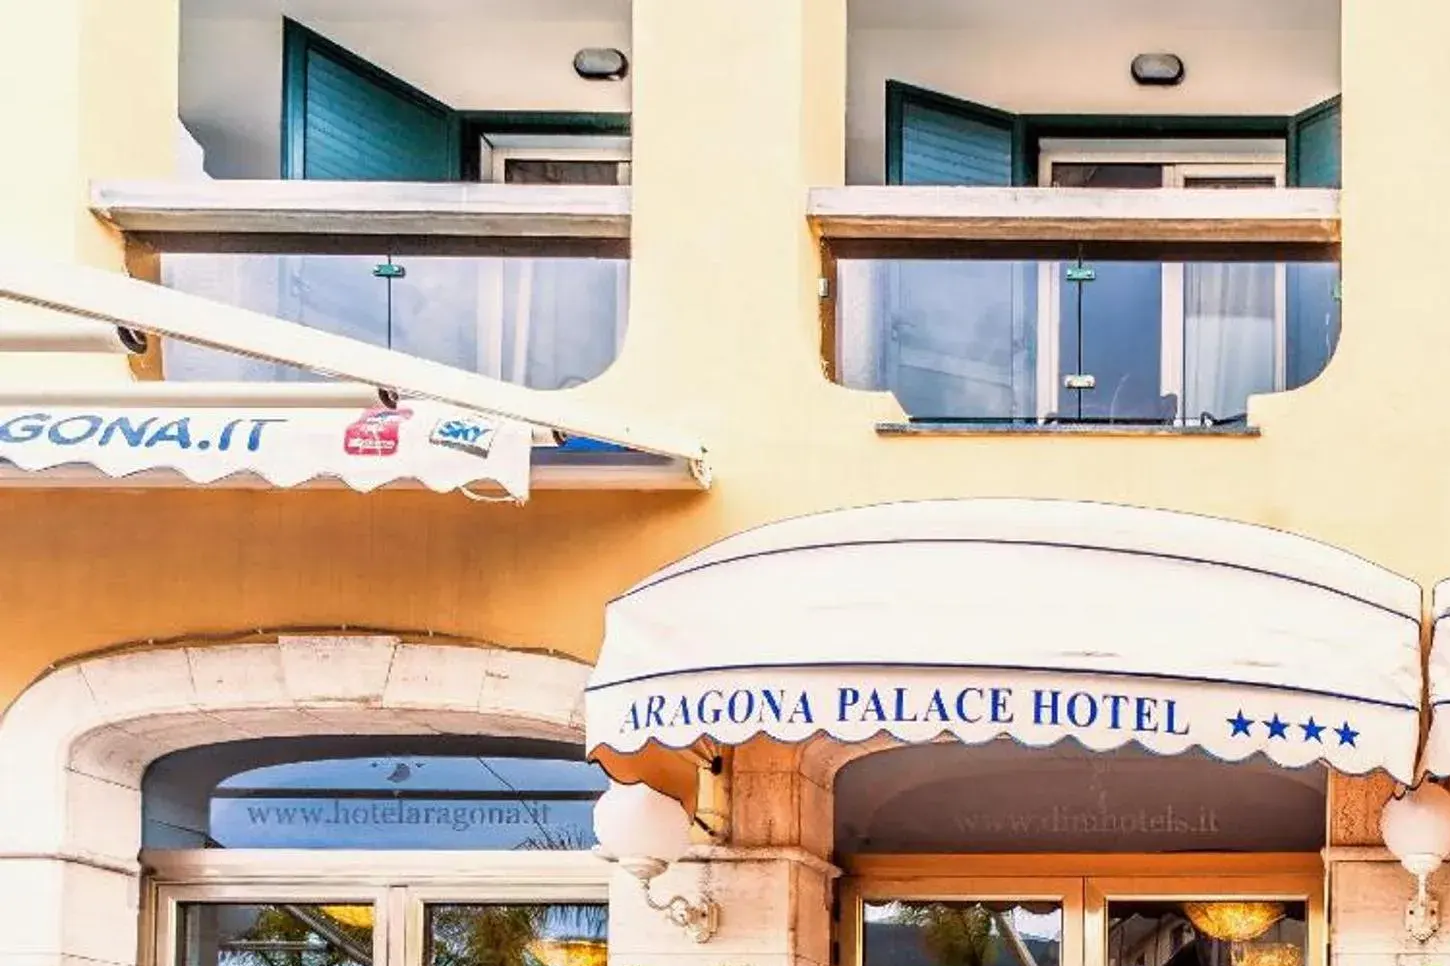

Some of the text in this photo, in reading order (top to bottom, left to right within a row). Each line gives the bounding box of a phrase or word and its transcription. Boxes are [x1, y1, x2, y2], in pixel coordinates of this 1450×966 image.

[619, 687, 1190, 735] ARAGONA PALACE HOTEL
[246, 800, 554, 831] www.hotelaragona.it
